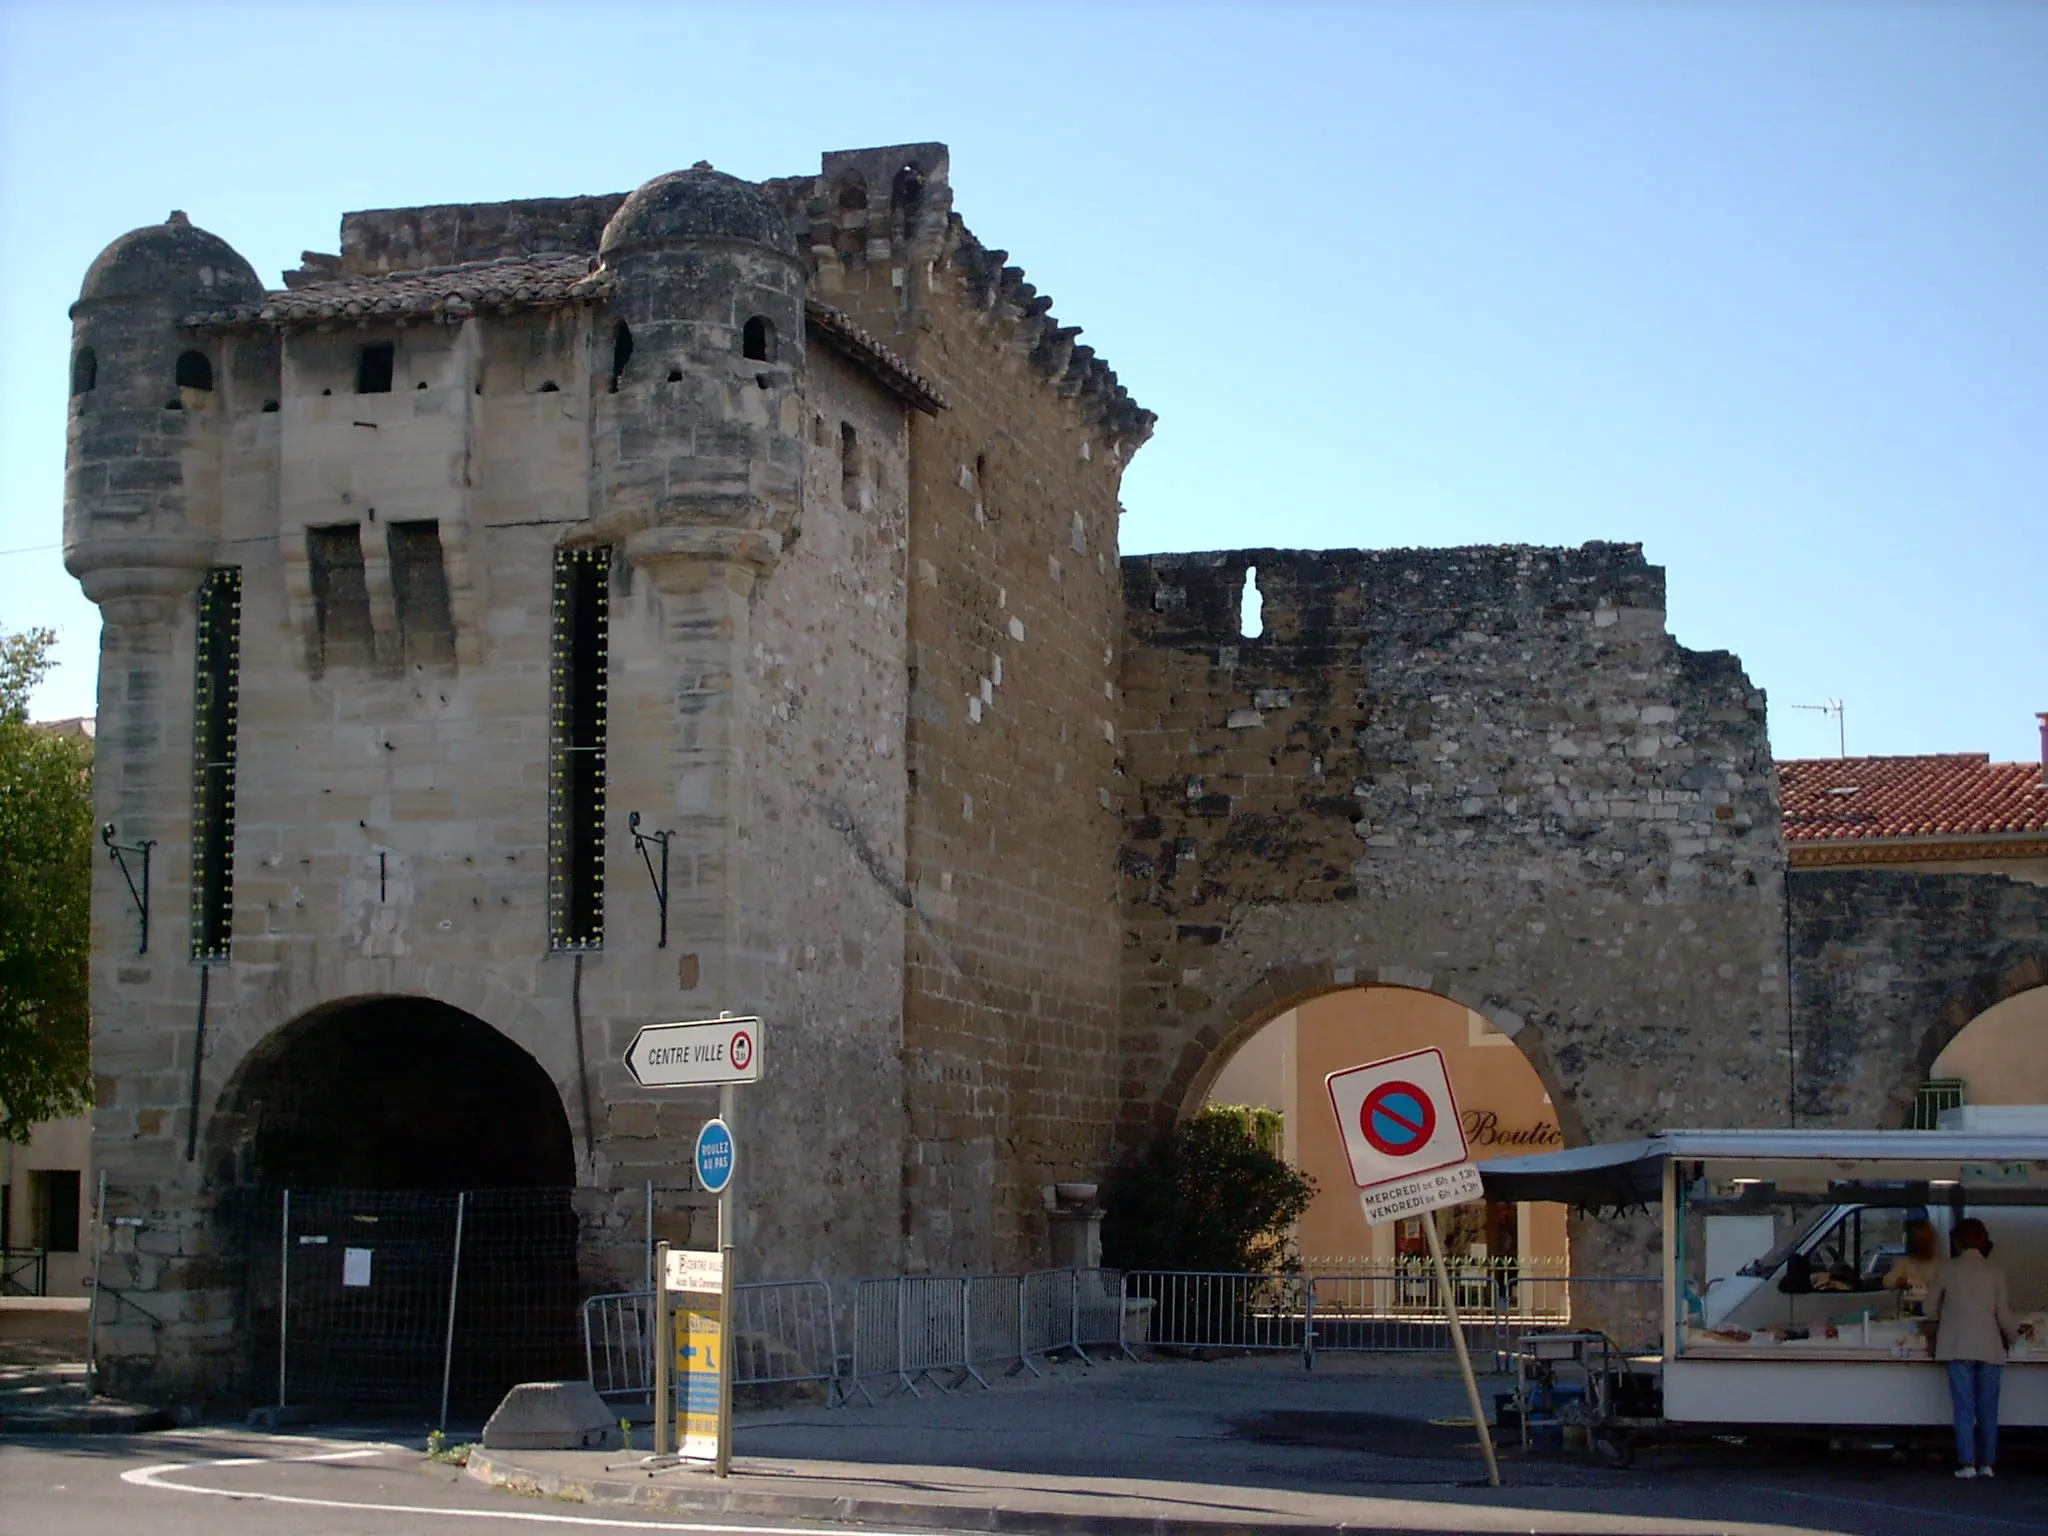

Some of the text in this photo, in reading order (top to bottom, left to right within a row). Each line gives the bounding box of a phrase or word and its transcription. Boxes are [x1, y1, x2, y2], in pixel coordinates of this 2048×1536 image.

[648, 1046, 690, 1065] CENTRE
[694, 1043, 724, 1063] VILLE
[701, 1141, 729, 1156] ROULEZ
[703, 1156, 729, 1170] AU PAS
[1365, 1183, 1420, 1206] MERCREDI
[1459, 1168, 1477, 1180] 13h
[1369, 1196, 1425, 1219] VENDREDI
[1462, 1182, 1479, 1193] 13h
